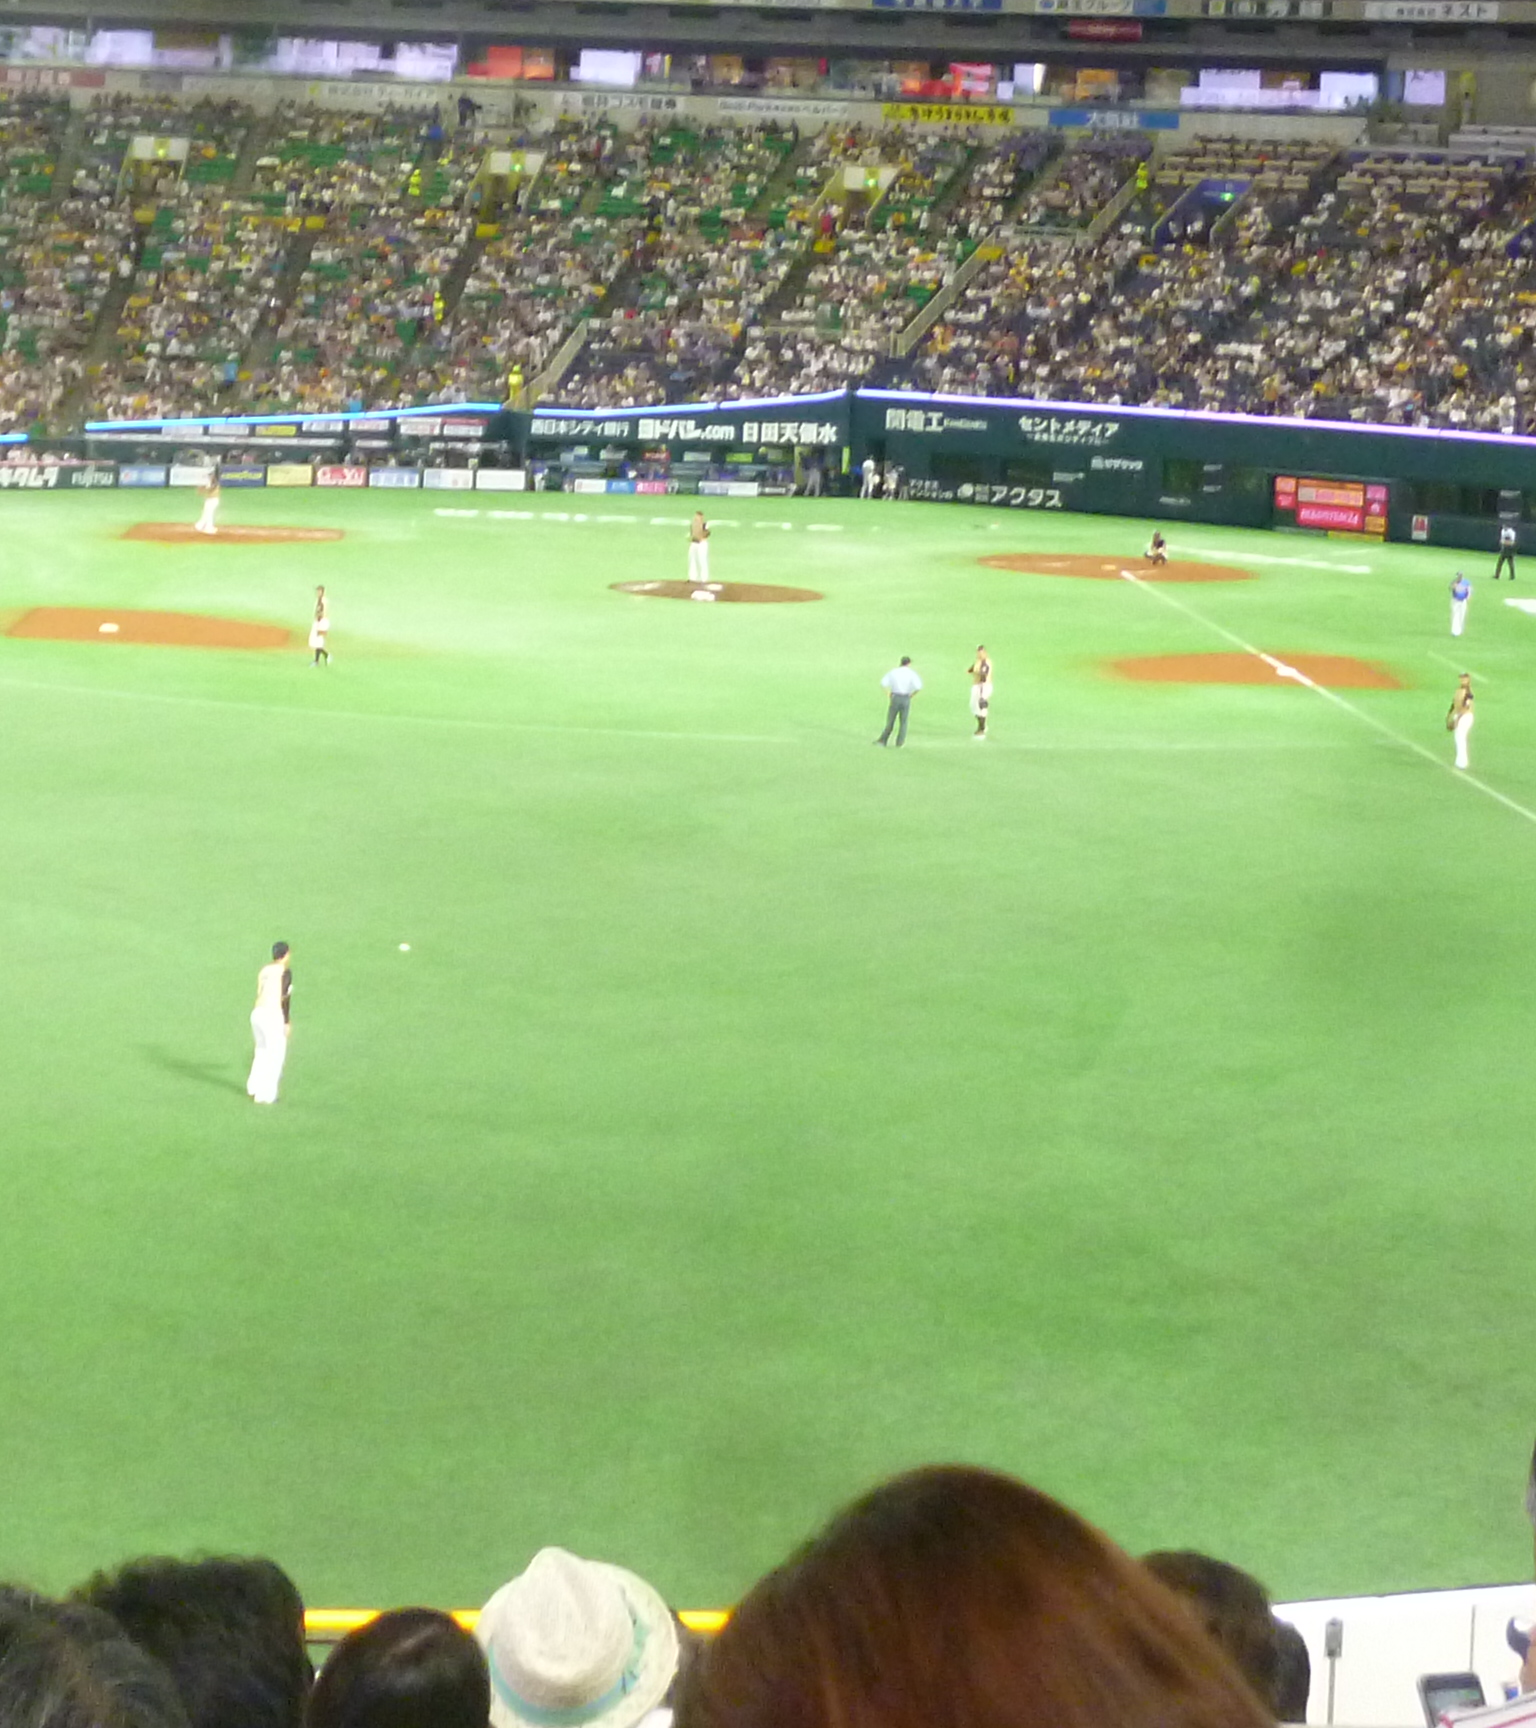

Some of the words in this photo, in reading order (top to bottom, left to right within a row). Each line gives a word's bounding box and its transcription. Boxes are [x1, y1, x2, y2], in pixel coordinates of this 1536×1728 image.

[743, 421, 837, 444] 日田天領水
[990, 483, 1063, 508] アクタス
